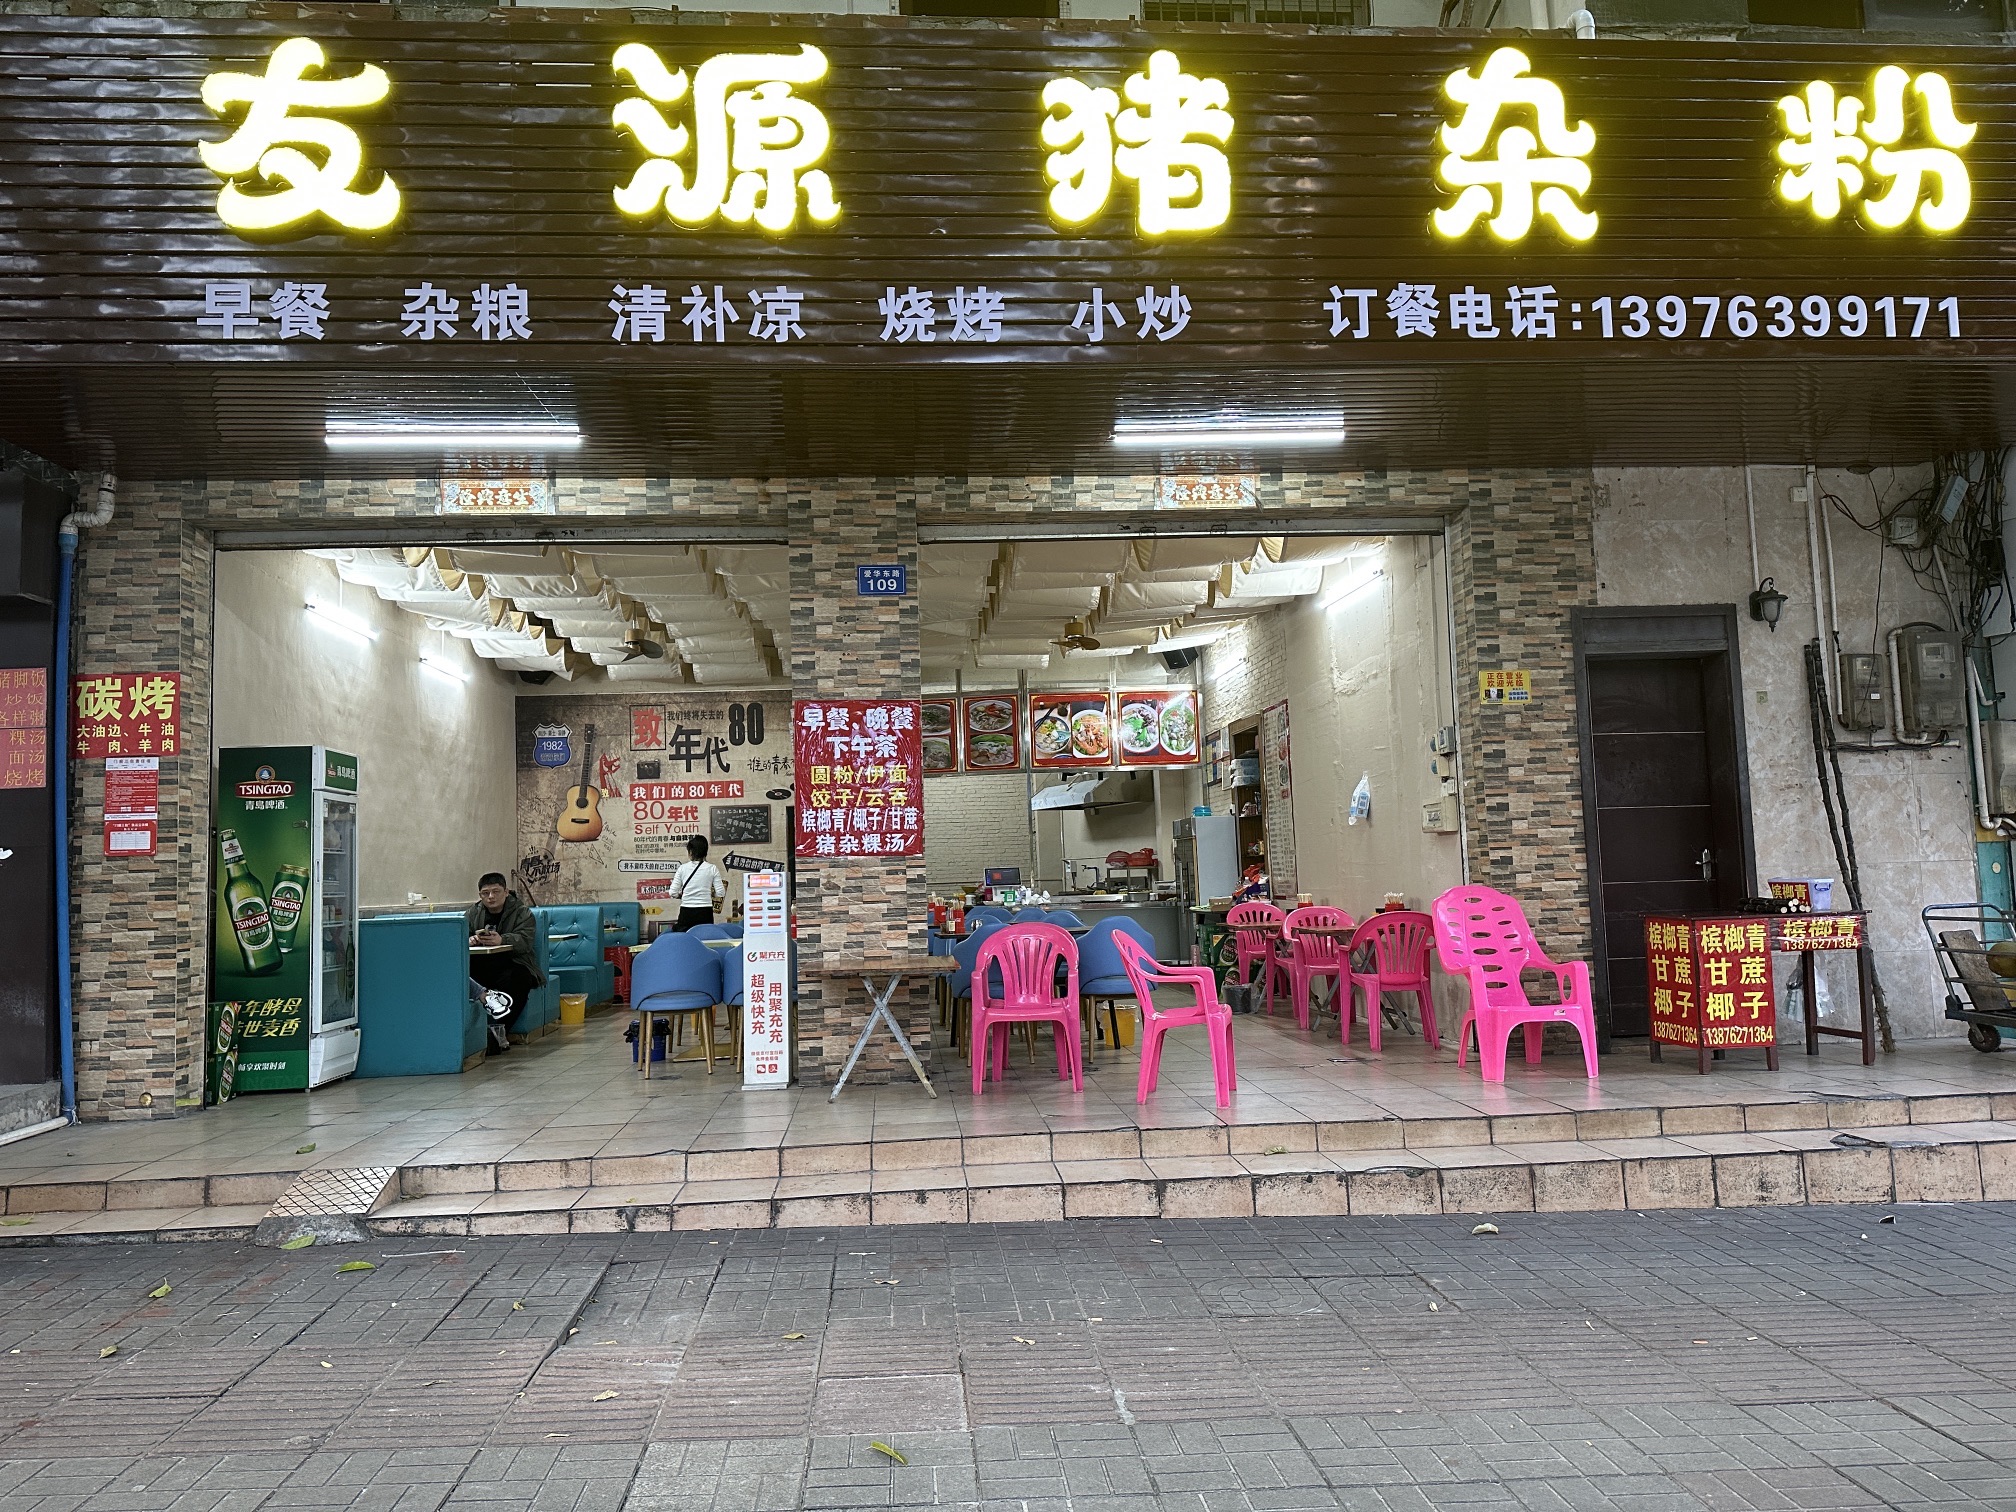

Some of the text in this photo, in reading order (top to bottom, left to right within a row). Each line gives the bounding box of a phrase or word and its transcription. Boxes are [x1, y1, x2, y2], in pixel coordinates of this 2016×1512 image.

[198, 37, 1978, 240] 友源猪杂粉
[197, 282, 1961, 343] 早餐 杂粮 清补凉 烧烤 小炒 订餐电话:13976399171
[863, 569, 900, 578] 爱华东路
[867, 579, 897, 591] 109
[4, 693, 44, 706] 炒饭
[76, 677, 176, 721] 碳烤
[667, 710, 724, 721] 我们终将失去的
[728, 703, 764, 746] 80
[802, 707, 914, 731] 早餐、晚餐
[632, 708, 662, 747] 致
[541, 740, 563, 751] 1982
[669, 724, 730, 773] 年代
[826, 735, 898, 759] 下午茶
[9, 750, 45, 765] 面汤
[3, 769, 44, 787] 烧烤
[810, 764, 907, 784] 圆粉/伊面
[240, 784, 292, 795] TSINGTAO
[633, 783, 742, 799] 我们的80年代
[810, 787, 908, 807] 饺子/云吞
[633, 801, 699, 821] 80 年代
[634, 823, 699, 835] Self Youth
[815, 833, 905, 854] 猪杂粿汤
[1771, 883, 1807, 900] 槟榔青
[271, 898, 300, 911] TSINGTAO
[235, 914, 269, 930] TSINGTAO
[1783, 918, 1858, 938] 槟榔青
[1649, 922, 1690, 954] 槟榔青
[1701, 923, 1766, 954] 槟榔青
[1784, 938, 1858, 950] 13876271364
[1652, 954, 1692, 985] 甘蔗
[1704, 956, 1767, 986] 甘蔗
[238, 998, 302, 1017] 年酵母
[751, 974, 765, 1035] 超级快充
[769, 982, 783, 1043] 用聚充充
[1654, 987, 1694, 1018] 椰子
[1706, 991, 1769, 1021] 椰子
[1653, 1020, 1698, 1044] 13876271364
[1706, 1025, 1773, 1045] 13876271364
